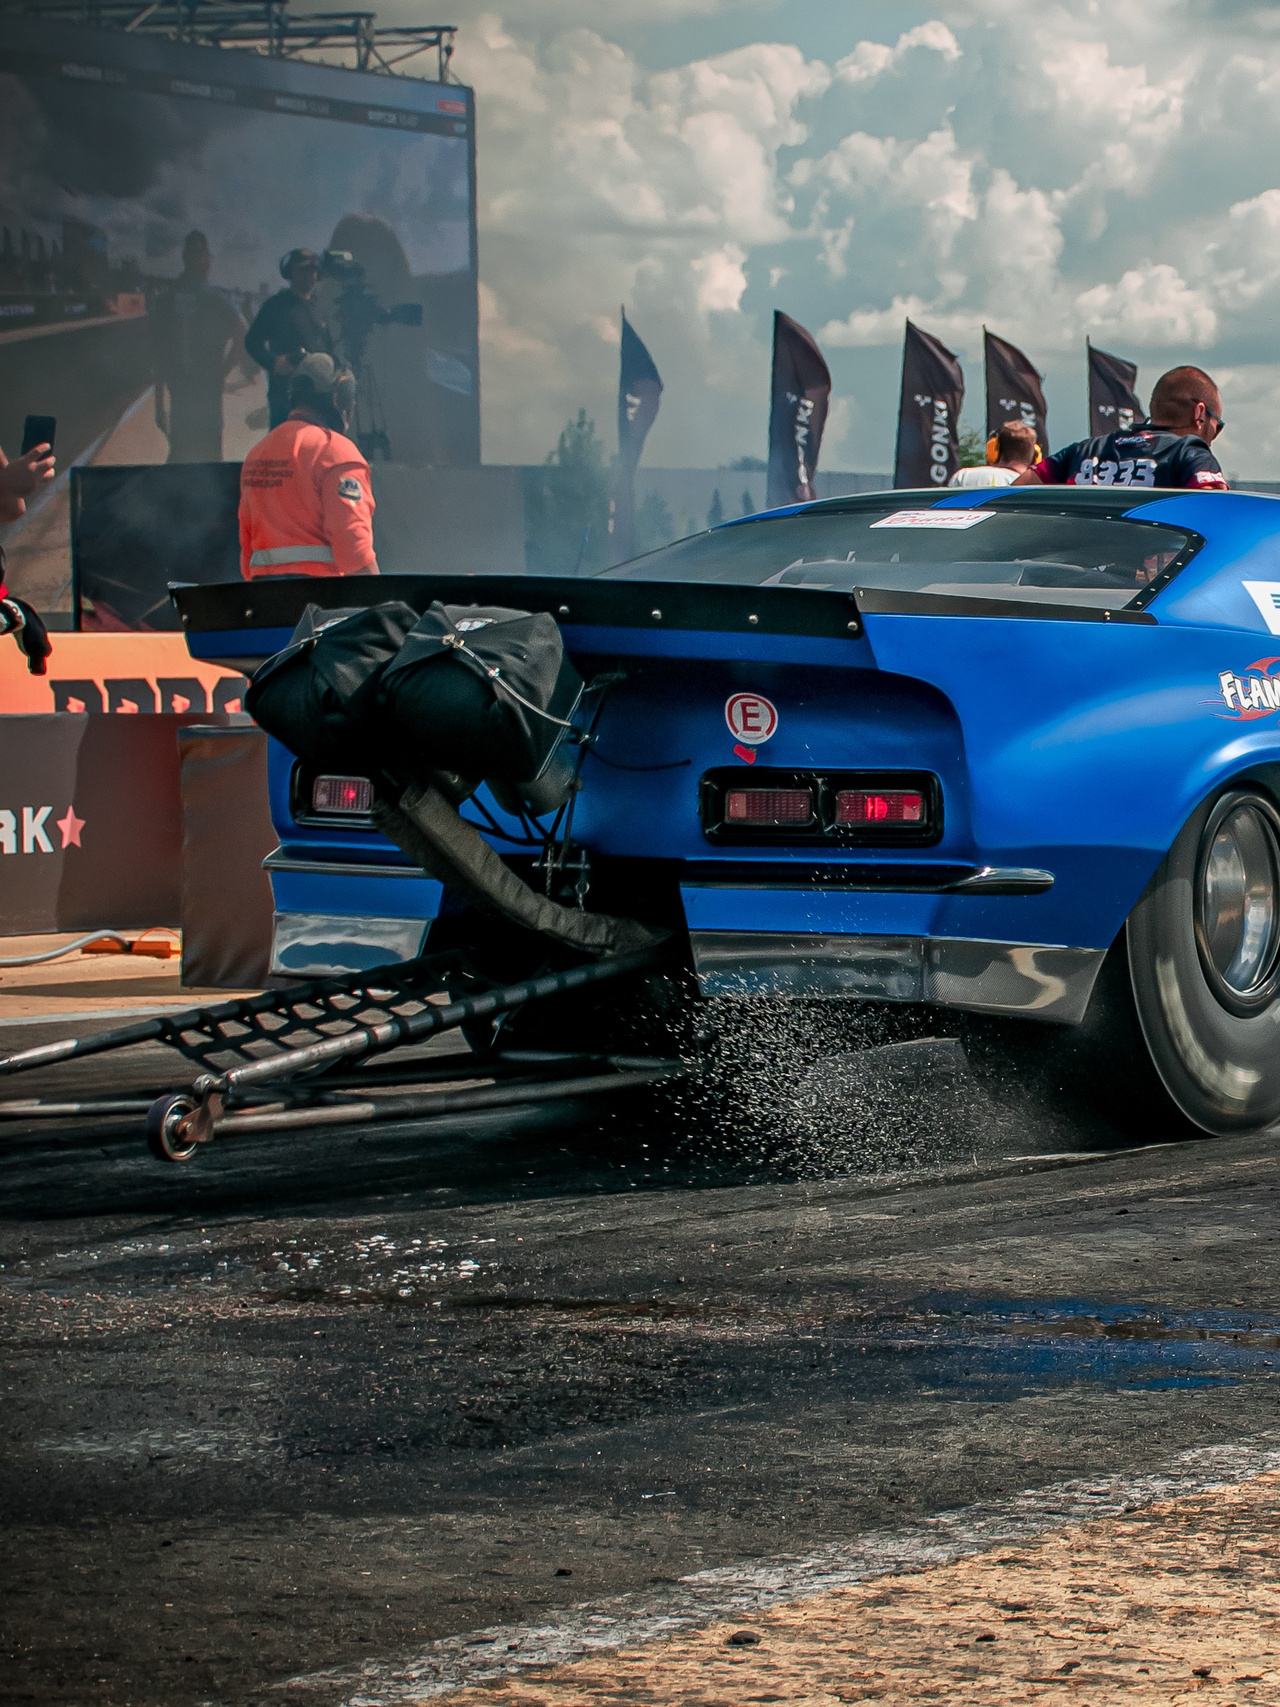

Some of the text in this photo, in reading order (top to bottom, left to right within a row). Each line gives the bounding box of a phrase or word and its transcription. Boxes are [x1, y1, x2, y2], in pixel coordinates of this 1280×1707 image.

[930, 400, 950, 484] GONKI
[1075, 458, 1157, 487] 8333
[740, 702, 762, 731] E
